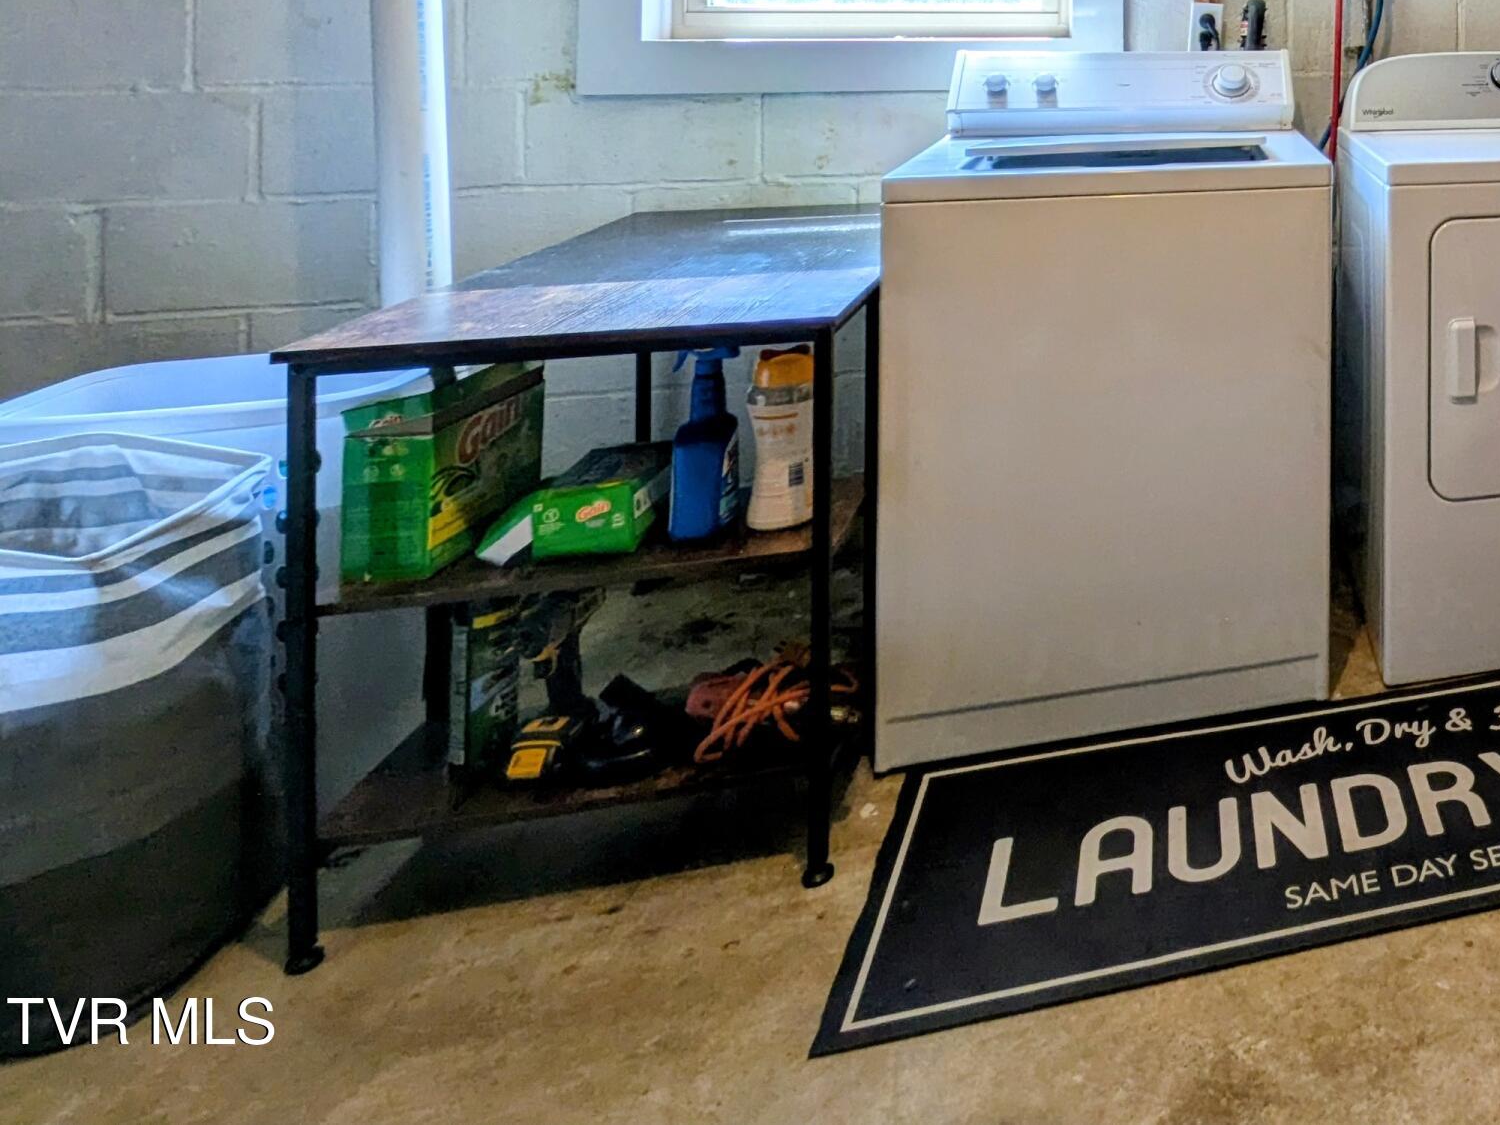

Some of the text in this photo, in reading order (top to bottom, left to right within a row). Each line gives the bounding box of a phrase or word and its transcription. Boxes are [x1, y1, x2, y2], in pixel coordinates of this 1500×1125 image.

[456, 393, 522, 466] Gain
[576, 500, 611, 522] Gain
[1355, 718, 1436, 748] Dry
[1445, 707, 1472, 731] &
[1285, 870, 1381, 910] SAME
[1391, 854, 1457, 888] DAY
